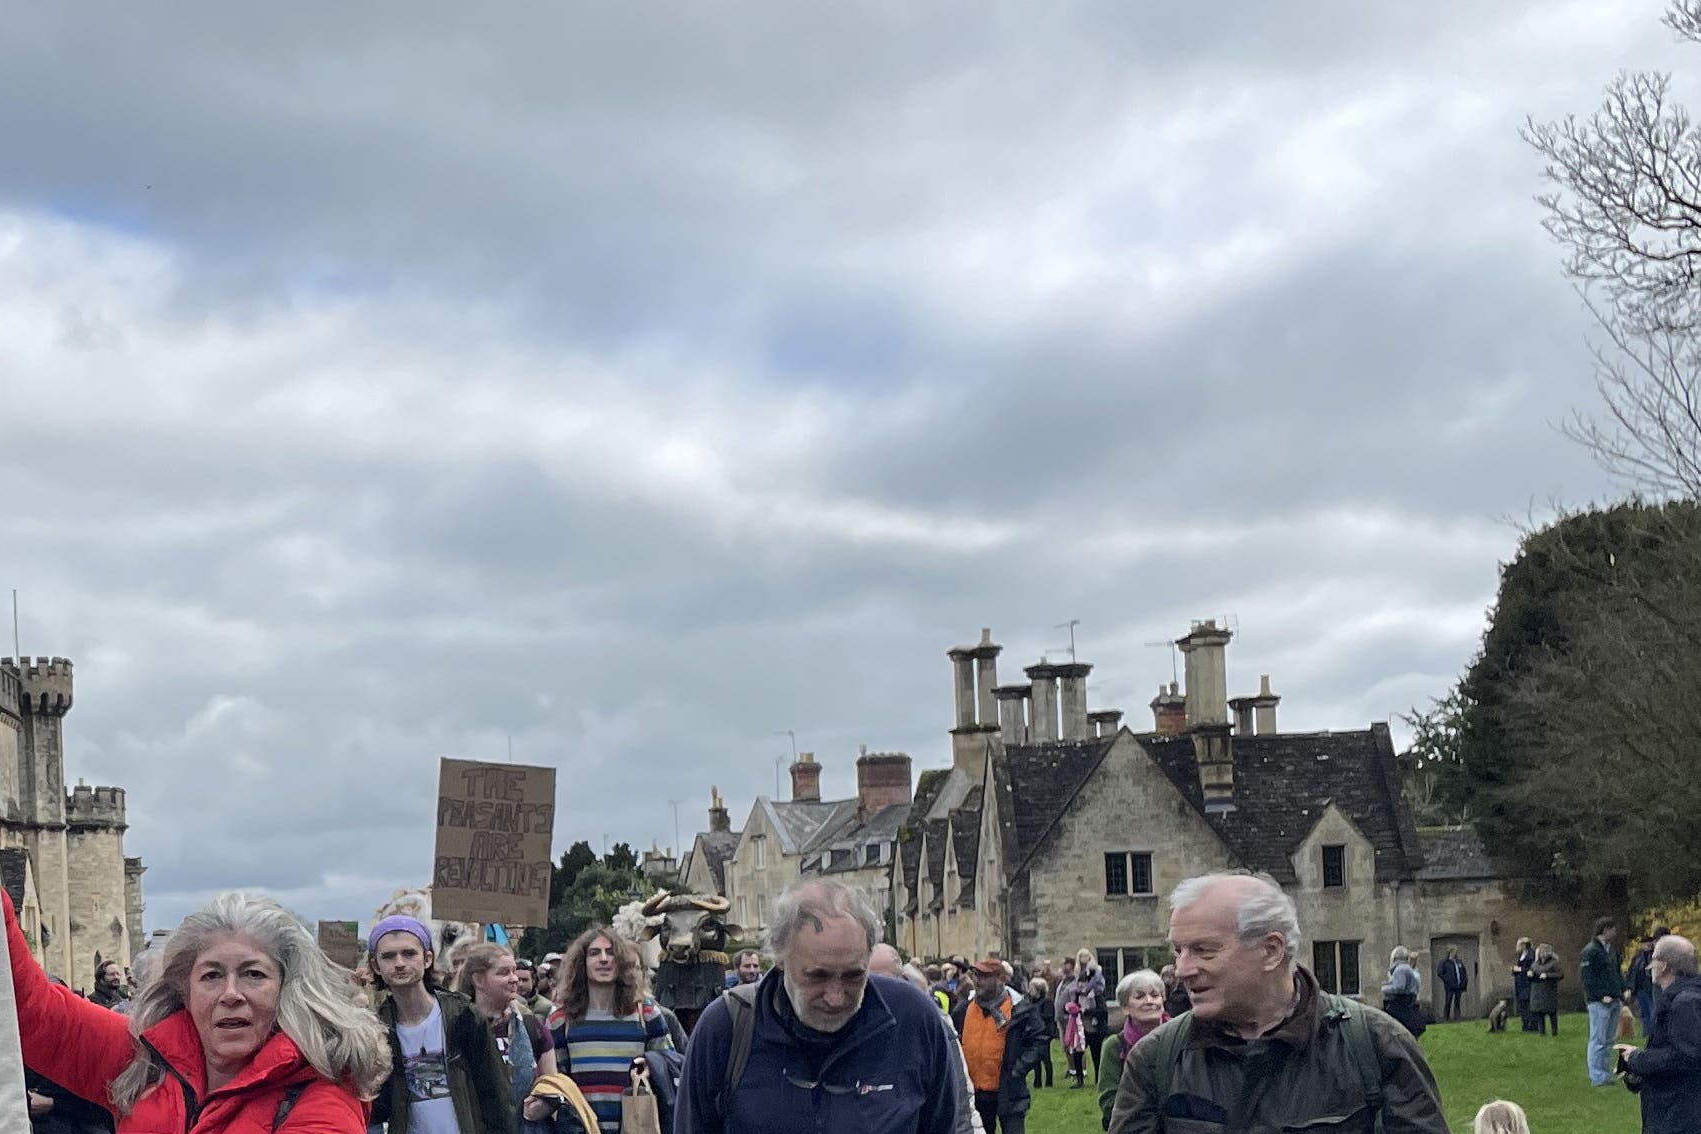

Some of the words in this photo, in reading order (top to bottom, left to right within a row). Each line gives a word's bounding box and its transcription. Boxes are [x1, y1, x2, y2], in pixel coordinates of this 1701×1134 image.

[461, 767, 526, 801] THE
[437, 796, 552, 834] PEASANTS
[470, 831, 524, 861] ARE
[434, 856, 550, 897] REVOLTING
